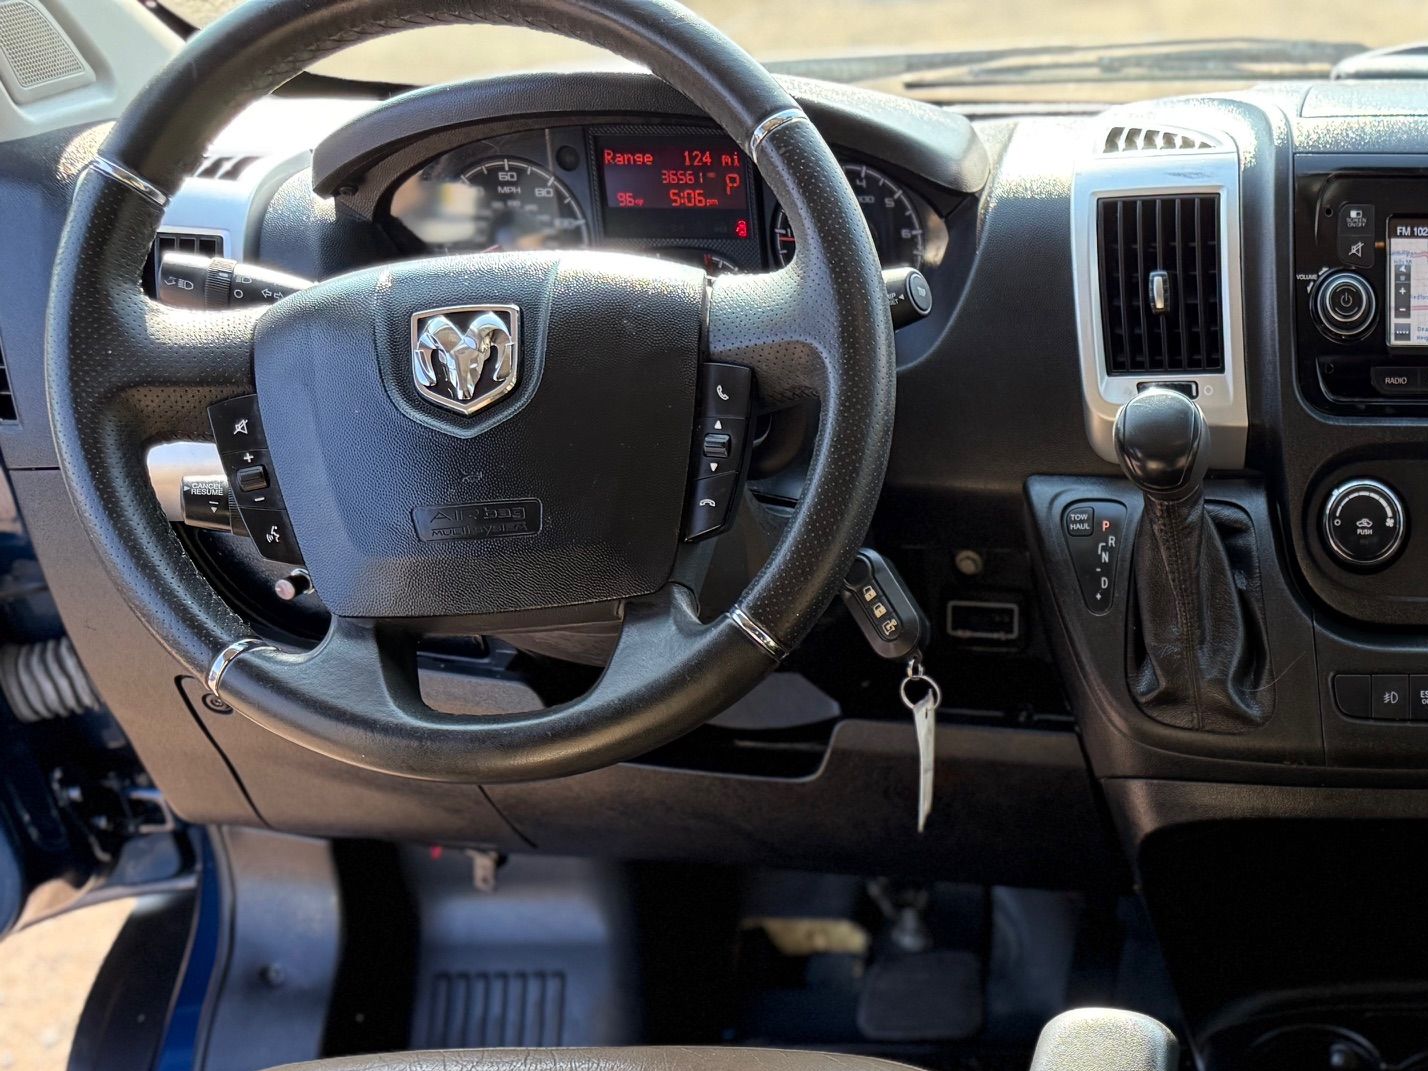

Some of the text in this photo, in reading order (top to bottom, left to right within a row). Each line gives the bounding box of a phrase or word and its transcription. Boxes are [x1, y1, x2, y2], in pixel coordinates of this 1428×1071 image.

[604, 149, 740, 167] Range 124 mi
[661, 170, 704, 184] 36561
[725, 173, 740, 195] P
[856, 178, 866, 189] 4
[497, 186, 521, 194] MPH
[901, 228, 911, 237] 6
[1397, 227, 1411, 236] FM
[1385, 377, 1407, 385] RADIO
[1102, 520, 1110, 532] P
[1108, 536, 1116, 547] R
[1101, 551, 1109, 563] N
[1101, 577, 1109, 589] D
